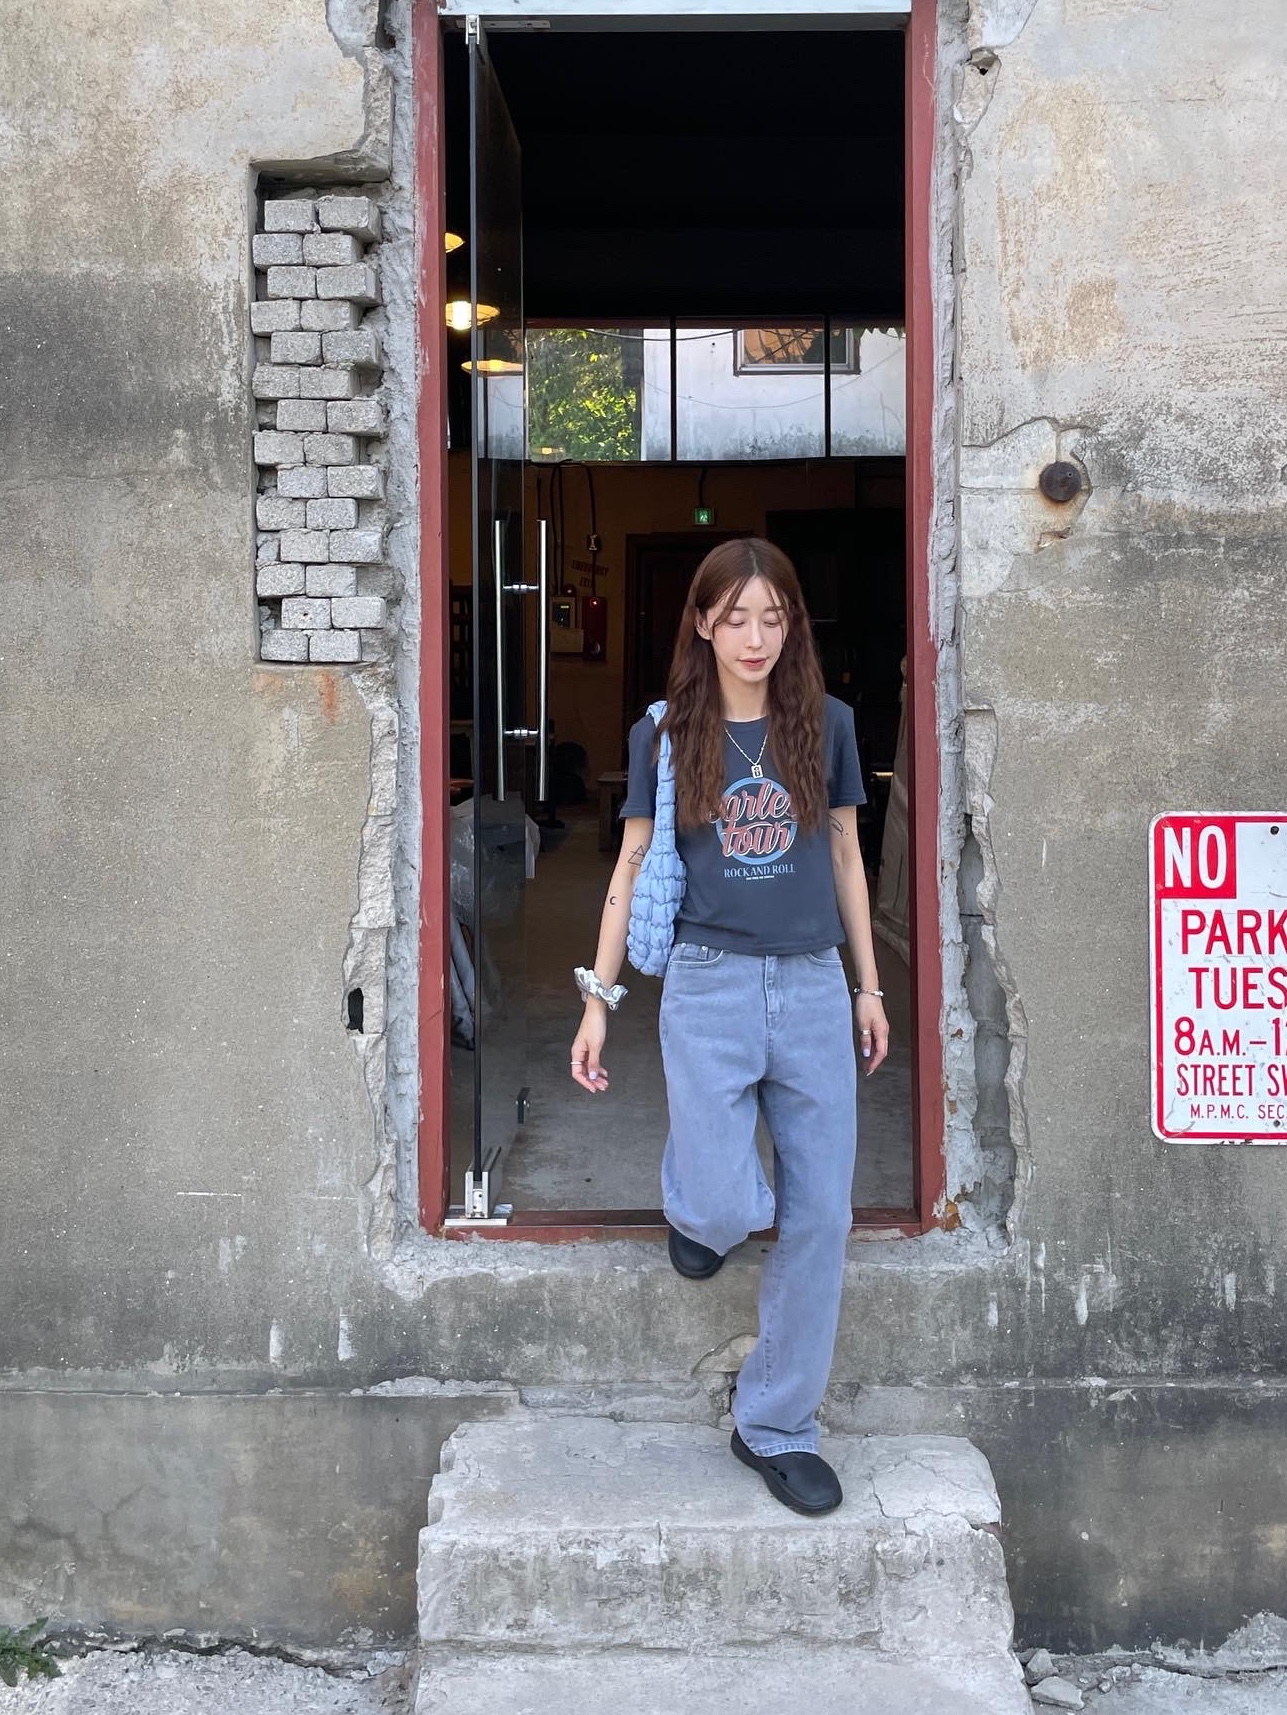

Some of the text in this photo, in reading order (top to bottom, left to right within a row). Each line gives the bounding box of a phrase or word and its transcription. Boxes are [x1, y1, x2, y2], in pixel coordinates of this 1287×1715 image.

[721, 820, 797, 858] tour
[1165, 825, 1227, 889] NO
[772, 863, 796, 874] ROLL
[1181, 909, 1287, 955] PARK
[1188, 966, 1287, 1010] TUES
[1177, 1064, 1256, 1096] STREET
[1190, 1105, 1249, 1119] M.P.M.C.
